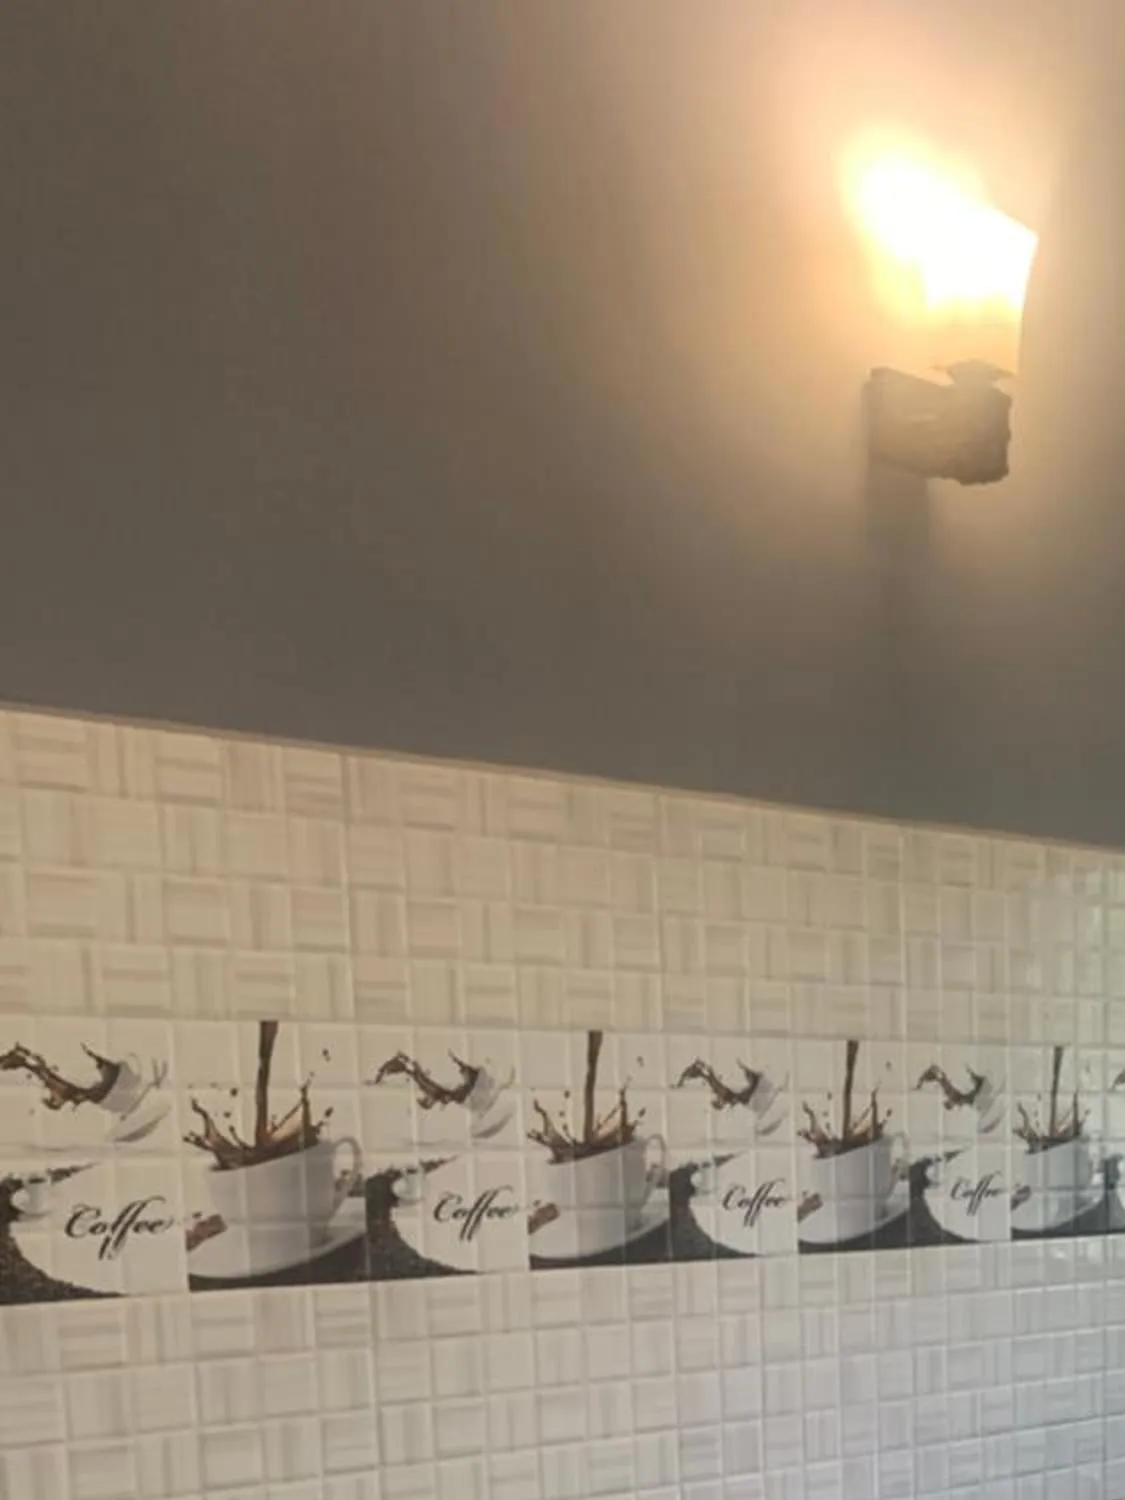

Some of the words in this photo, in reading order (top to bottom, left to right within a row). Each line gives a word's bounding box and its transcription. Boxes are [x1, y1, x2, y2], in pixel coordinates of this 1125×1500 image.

[433, 1184, 519, 1243] Coffee
[722, 1177, 787, 1228] Coffee
[950, 1169, 1006, 1217] Coffee
[64, 1194, 174, 1261] Coffee
